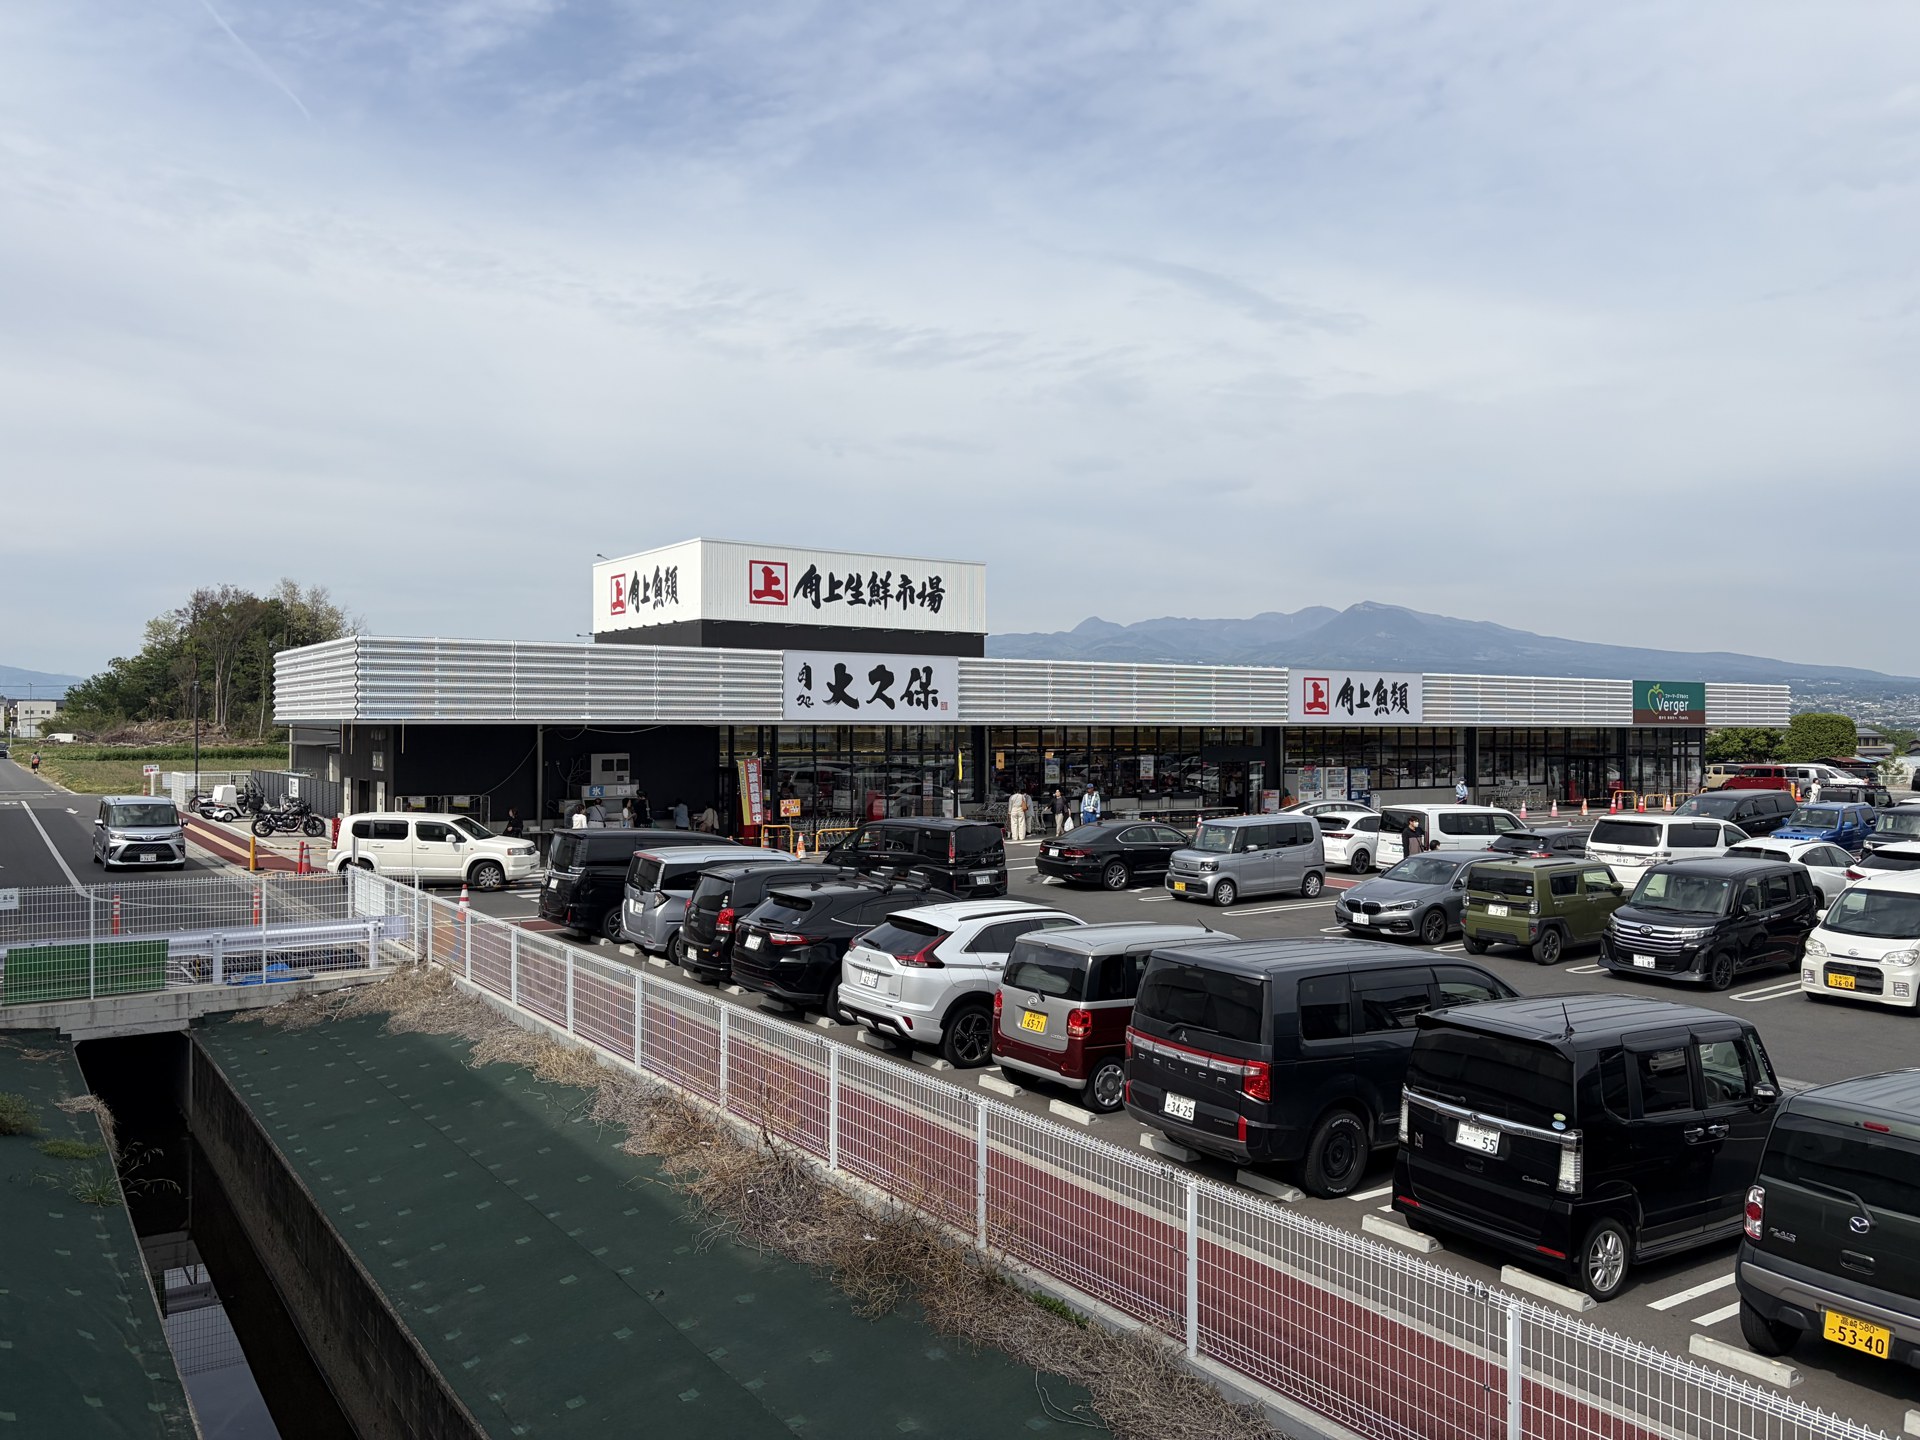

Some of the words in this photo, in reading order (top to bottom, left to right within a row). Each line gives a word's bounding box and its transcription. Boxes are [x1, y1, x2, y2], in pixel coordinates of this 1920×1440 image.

[611, 578, 625, 611] 上
[628, 565, 679, 614] 角上魚類
[752, 565, 785, 601] 上
[793, 563, 946, 614] 角上生鮮市場
[822, 662, 939, 711] 大久保
[1306, 681, 1327, 711] 上
[1335, 677, 1410, 717] 角上魚類
[1656, 697, 1689, 716] Verger
[1834, 979, 1854, 988] 36-04
[1026, 1019, 1044, 1031] 65-71
[1138, 1052, 1227, 1085] DELICA
[1170, 1101, 1193, 1119] 34-25
[1837, 1325, 1885, 1355] 53-40
